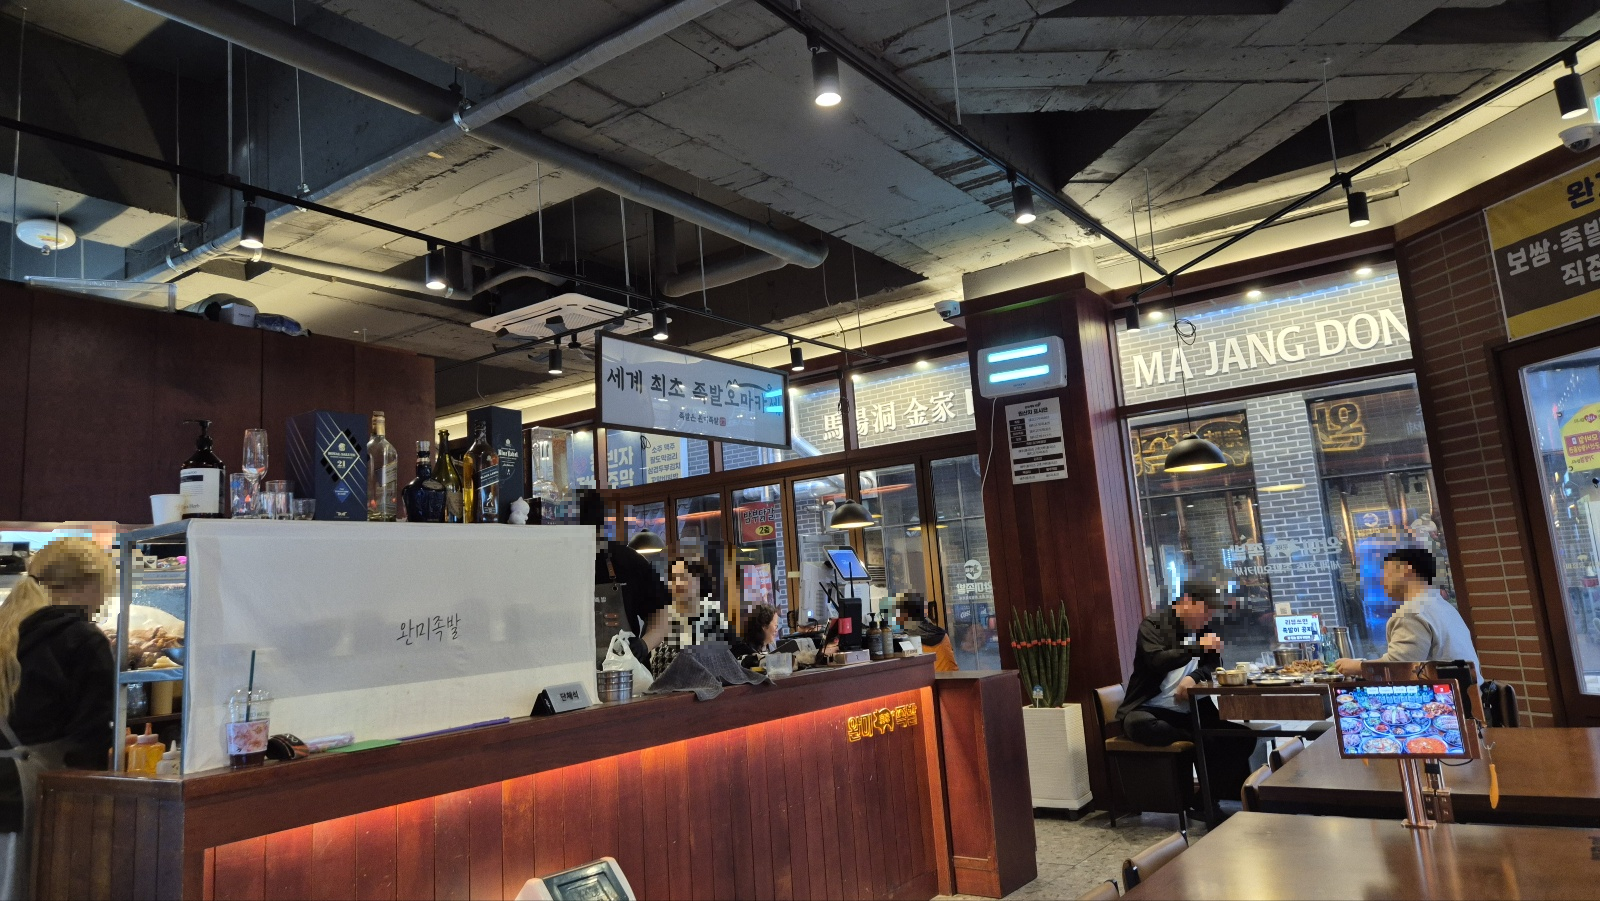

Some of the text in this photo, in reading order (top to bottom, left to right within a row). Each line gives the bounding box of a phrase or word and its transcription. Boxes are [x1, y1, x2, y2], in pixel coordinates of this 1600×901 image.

[1133, 347, 1193, 388] MA
[1205, 326, 1306, 376] JANG
[607, 366, 643, 394] 세계
[650, 374, 686, 398] 최초
[651, 442, 675, 454] 소주 맥주
[396, 613, 461, 645] 완미족발
[559, 690, 580, 702] 단체석
[847, 713, 874, 742] 완미
